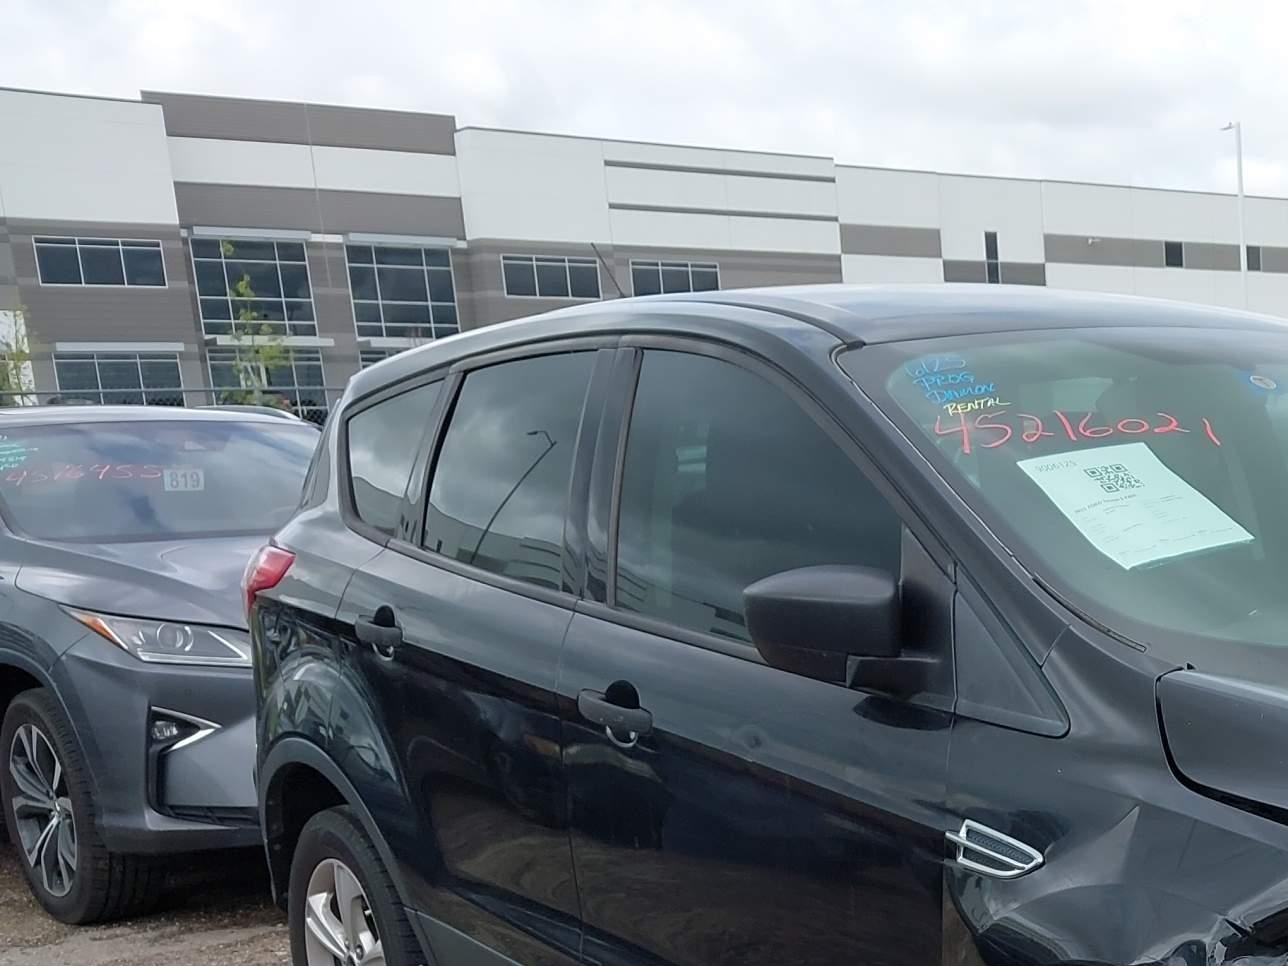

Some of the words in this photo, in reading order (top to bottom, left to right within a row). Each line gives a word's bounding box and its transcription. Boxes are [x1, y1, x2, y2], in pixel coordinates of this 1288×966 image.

[943, 397, 1012, 416] RENTAL
[935, 410, 1220, 454] 45216021
[169, 471, 200, 489] 819
